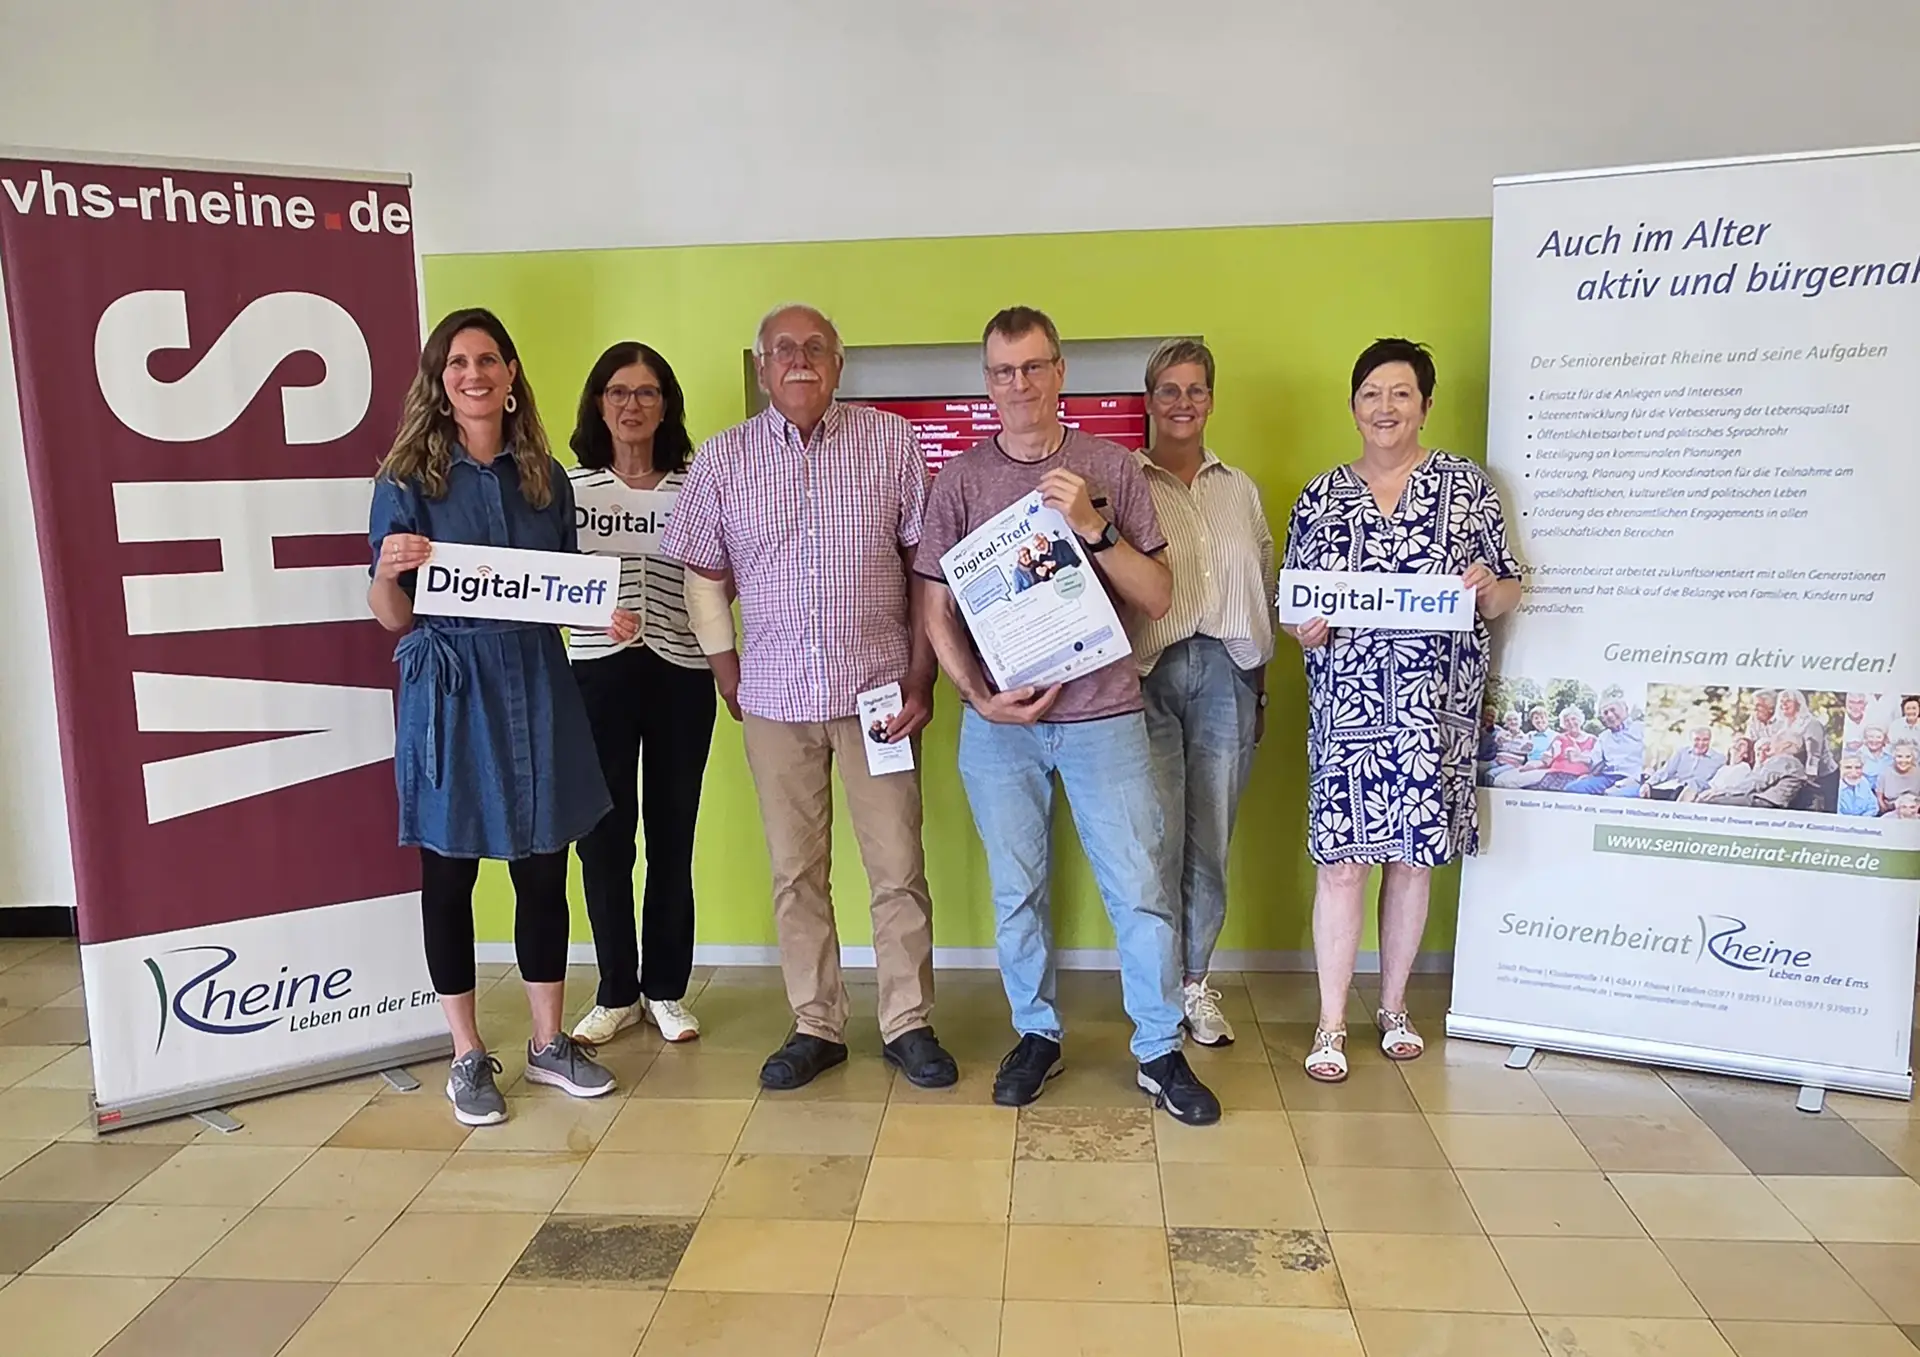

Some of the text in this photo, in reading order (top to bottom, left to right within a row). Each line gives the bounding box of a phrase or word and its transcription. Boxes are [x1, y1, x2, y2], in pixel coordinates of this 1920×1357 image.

[2, 169, 411, 235] vhs-rheine.de
[1536, 217, 1772, 258] Auch im Alter
[1576, 268, 1661, 301] aktiv
[1669, 263, 1738, 297] und
[1530, 343, 1888, 369] Der Seniorenbeirat Rheine und seine Aufgaben
[1539, 386, 1742, 402] Einsatz für die Anliegen und Interessen
[1538, 403, 1849, 422] Ideenentwicklung für die Verbesserung der Lebensqualität
[1537, 425, 1789, 440] Öffentlichkeitsarbeit und politisches Sprachrohr
[1536, 447, 1741, 462] Beteiligung an kommunalen Planungen
[1534, 466, 1853, 481] Förderung, Planung und Koordination für die Teilnahme am
[1628, 487, 1684, 499] kulturellen
[1687, 487, 1708, 499] und
[1711, 487, 1771, 500] politischen
[1774, 487, 1807, 498] Leben
[1532, 507, 1808, 521] Förderung des ehrenamtlichen Engagements in allen
[1531, 526, 1674, 539] gesellschaftlichen Bereichen
[94, 290, 396, 825] VHS
[953, 518, 1033, 580] Digital-Treff
[427, 564, 608, 605] Digital-Treff
[1519, 564, 1886, 582] Der Seniorenbeirat arbeitet zukunftsorientiert mit allen Generationen
[1291, 583, 1460, 616] Digital-Treff
[1574, 583, 1594, 595] und
[1596, 584, 1614, 596] hat
[1617, 585, 1641, 596] Blick
[1643, 586, 1661, 598] auf
[1664, 586, 1679, 597] die
[1682, 586, 1725, 600] Belange
[1727, 589, 1748, 598] von
[1802, 589, 1847, 601] Kindern
[1850, 590, 1874, 602] und
[1604, 642, 1897, 673] Gemeinsam aktiv werden!
[1607, 833, 1880, 871] www.seniorenbeirat-rheine.de
[1498, 912, 1812, 971] Seniorenbeirat Rheine
[1769, 968, 1869, 990] Leben an der Ems
[142, 944, 352, 1055] Rheine
[289, 1008, 342, 1033] Leben
[348, 1004, 370, 1020] an
[376, 995, 405, 1014] der
